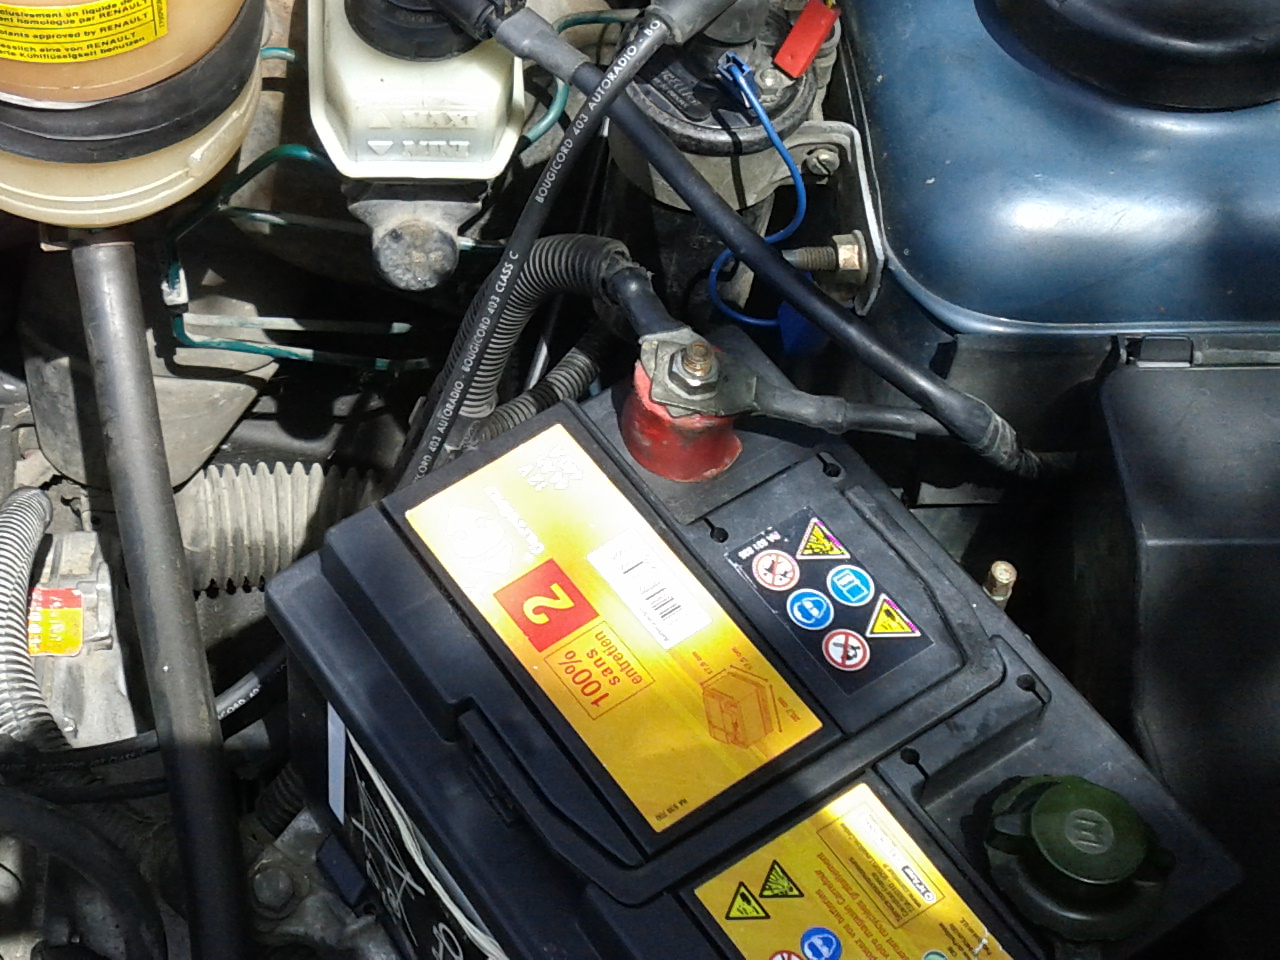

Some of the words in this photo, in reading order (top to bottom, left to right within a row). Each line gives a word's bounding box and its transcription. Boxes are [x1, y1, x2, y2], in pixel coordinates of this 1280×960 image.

[32, 29, 81, 41] approved
[83, 28, 97, 39] by
[99, 12, 148, 34] RENAULT
[66, 10, 78, 18] un
[82, 3, 113, 17] liquide
[79, 14, 96, 26] par
[39, 45, 60, 53] eine
[63, 44, 84, 52] von
[87, 31, 137, 49] RENAULT
[100, 36, 145, 55] benutzen
[534, 138, 573, 203] BOUGICORD
[572, 112, 589, 136] 403
[588, 45, 638, 111] AUTORADIO
[427, 435, 441, 452] 403
[436, 380, 464, 433] AUTORADIO
[461, 316, 491, 372] BOUGICORD
[487, 294, 500, 315] 403
[494, 261, 514, 293] CLASS
[508, 250, 519, 260] C
[518, 577, 575, 633] 2
[584, 646, 621, 688] sans
[591, 629, 643, 687] entretien
[554, 647, 612, 710] 100%
[813, 869, 846, 906] Carrefour
[816, 851, 860, 900] gratuitement
[814, 888, 845, 924] batteries
[843, 904, 874, 938] magasin
[856, 899, 889, 937] recyclées
[870, 937, 890, 959] votre
